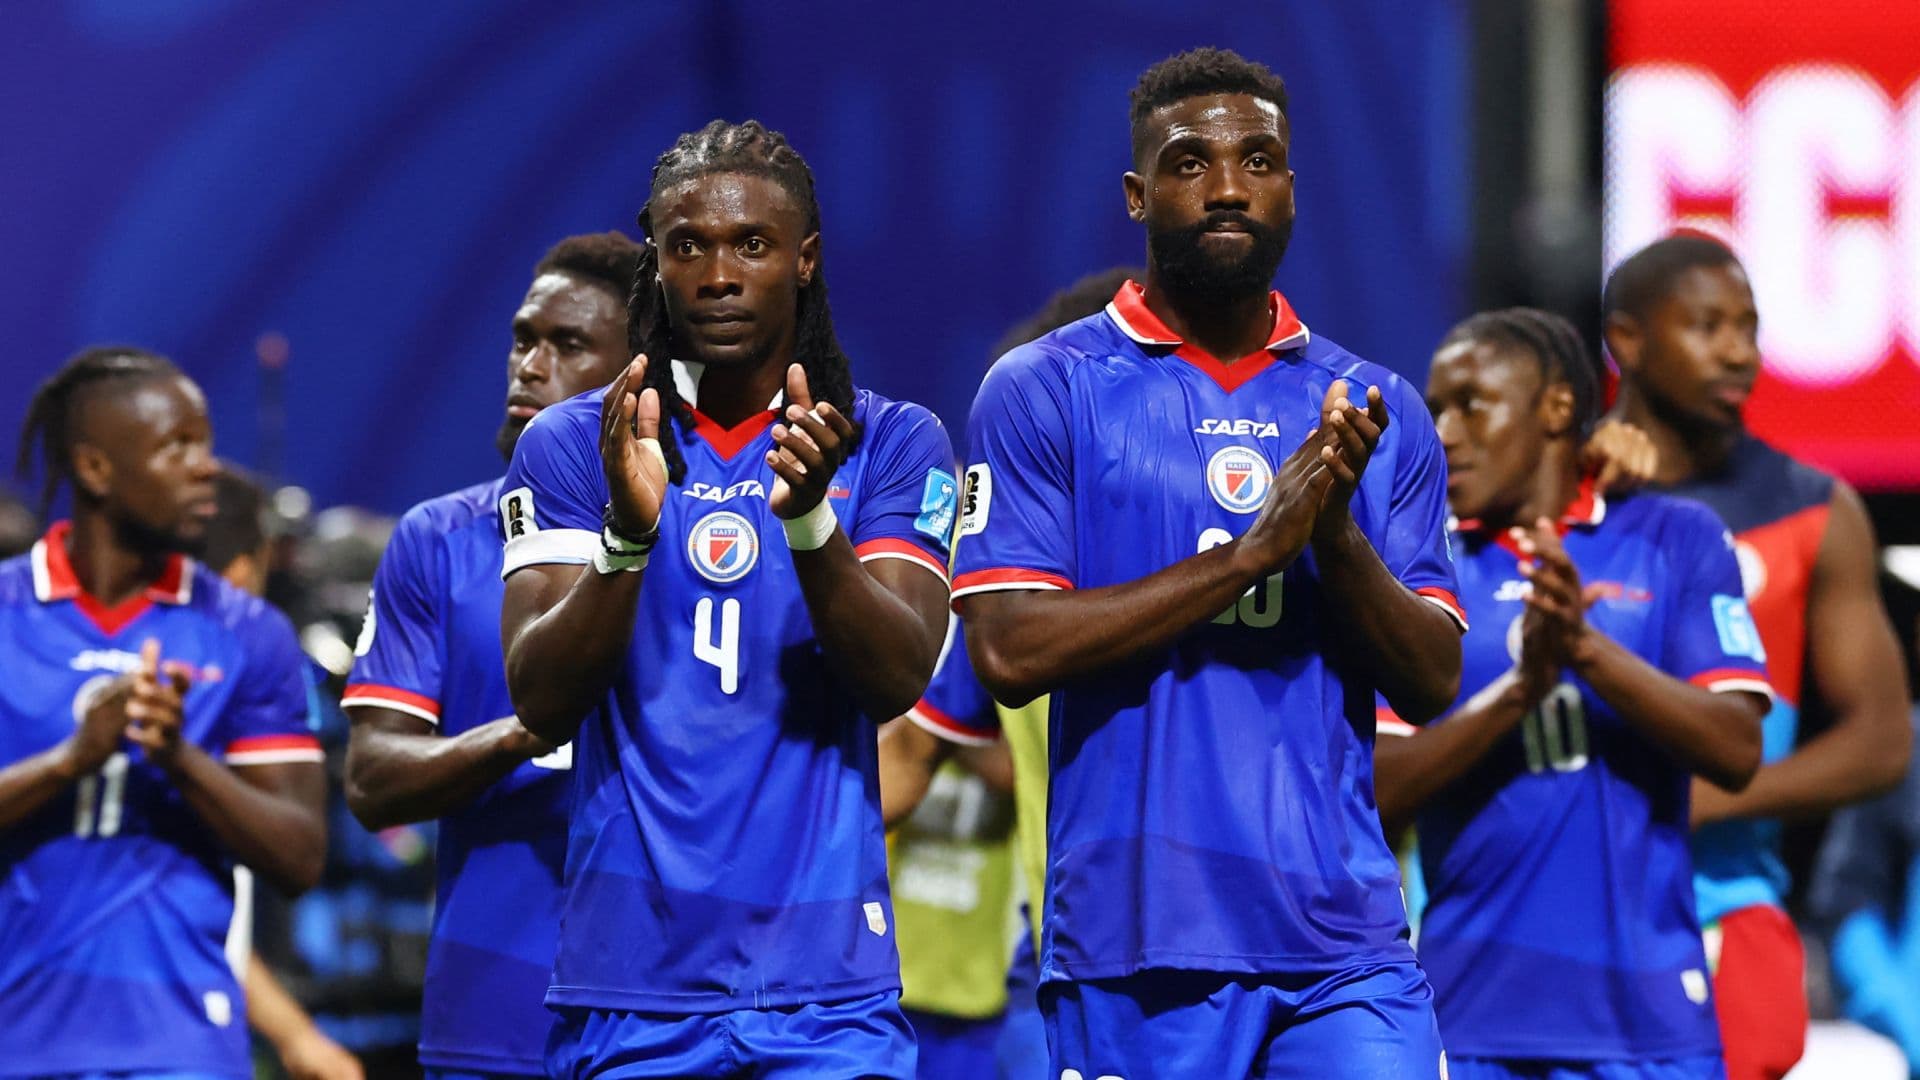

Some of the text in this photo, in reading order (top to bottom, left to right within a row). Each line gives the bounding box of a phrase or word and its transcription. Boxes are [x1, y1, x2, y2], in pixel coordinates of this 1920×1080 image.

[1194, 419, 1280, 438] SAETA
[1227, 462, 1250, 470] HAITI
[682, 480, 765, 503] SAETA
[712, 528, 737, 536] HAITI
[694, 597, 740, 695] 4
